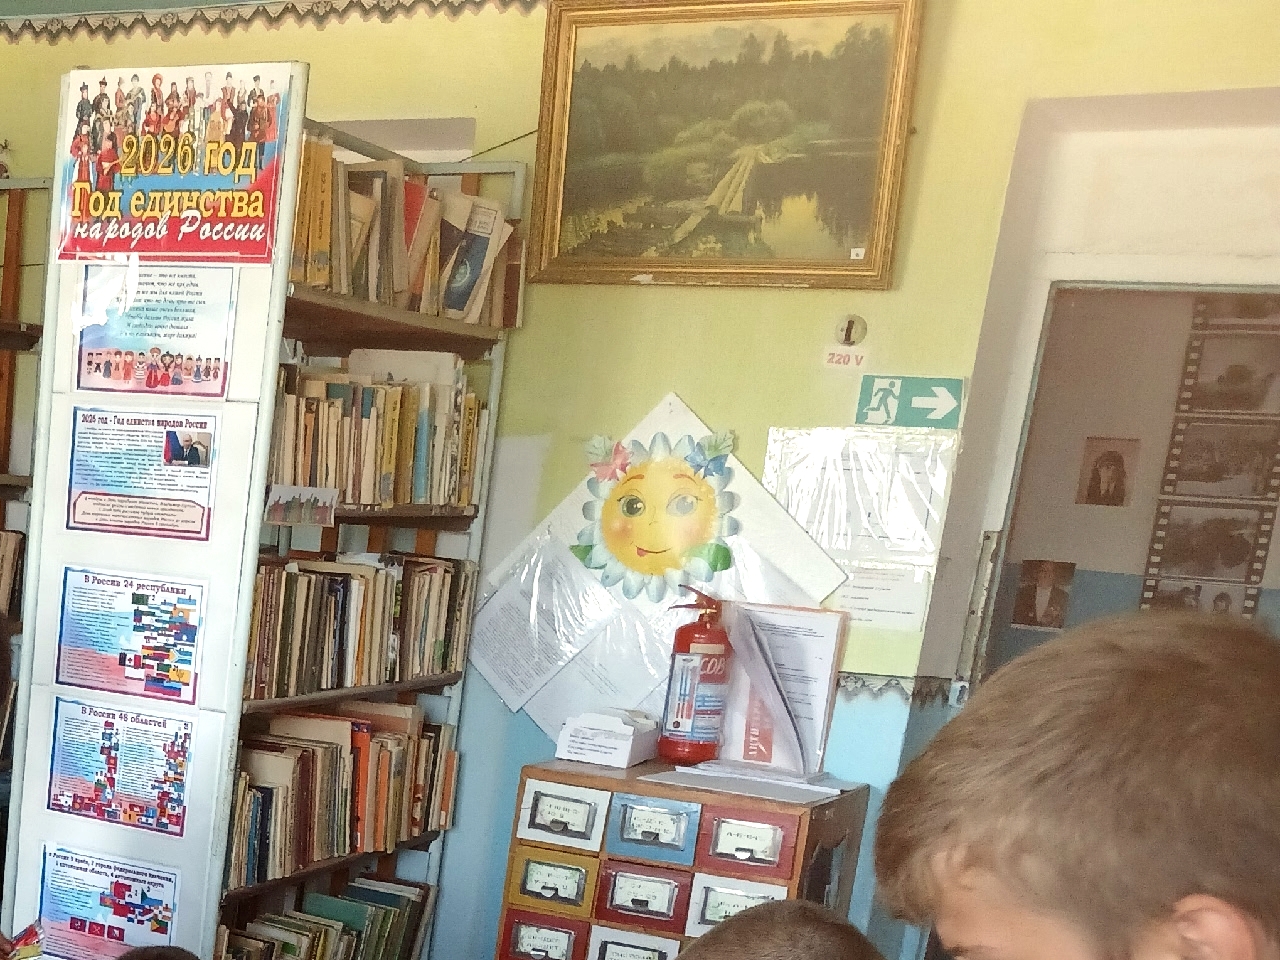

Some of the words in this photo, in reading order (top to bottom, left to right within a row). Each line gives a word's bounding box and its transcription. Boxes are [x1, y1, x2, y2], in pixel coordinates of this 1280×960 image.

[120, 131, 196, 175] 2026
[204, 140, 257, 183] год
[71, 181, 123, 221] Год
[130, 188, 265, 221] единства
[74, 211, 170, 248] народов
[178, 210, 266, 241] России
[827, 352, 851, 366] 220
[852, 354, 864, 367] V
[91, 576, 121, 588] России
[123, 579, 135, 589] 24
[136, 583, 187, 596] республики
[88, 707, 117, 720] России
